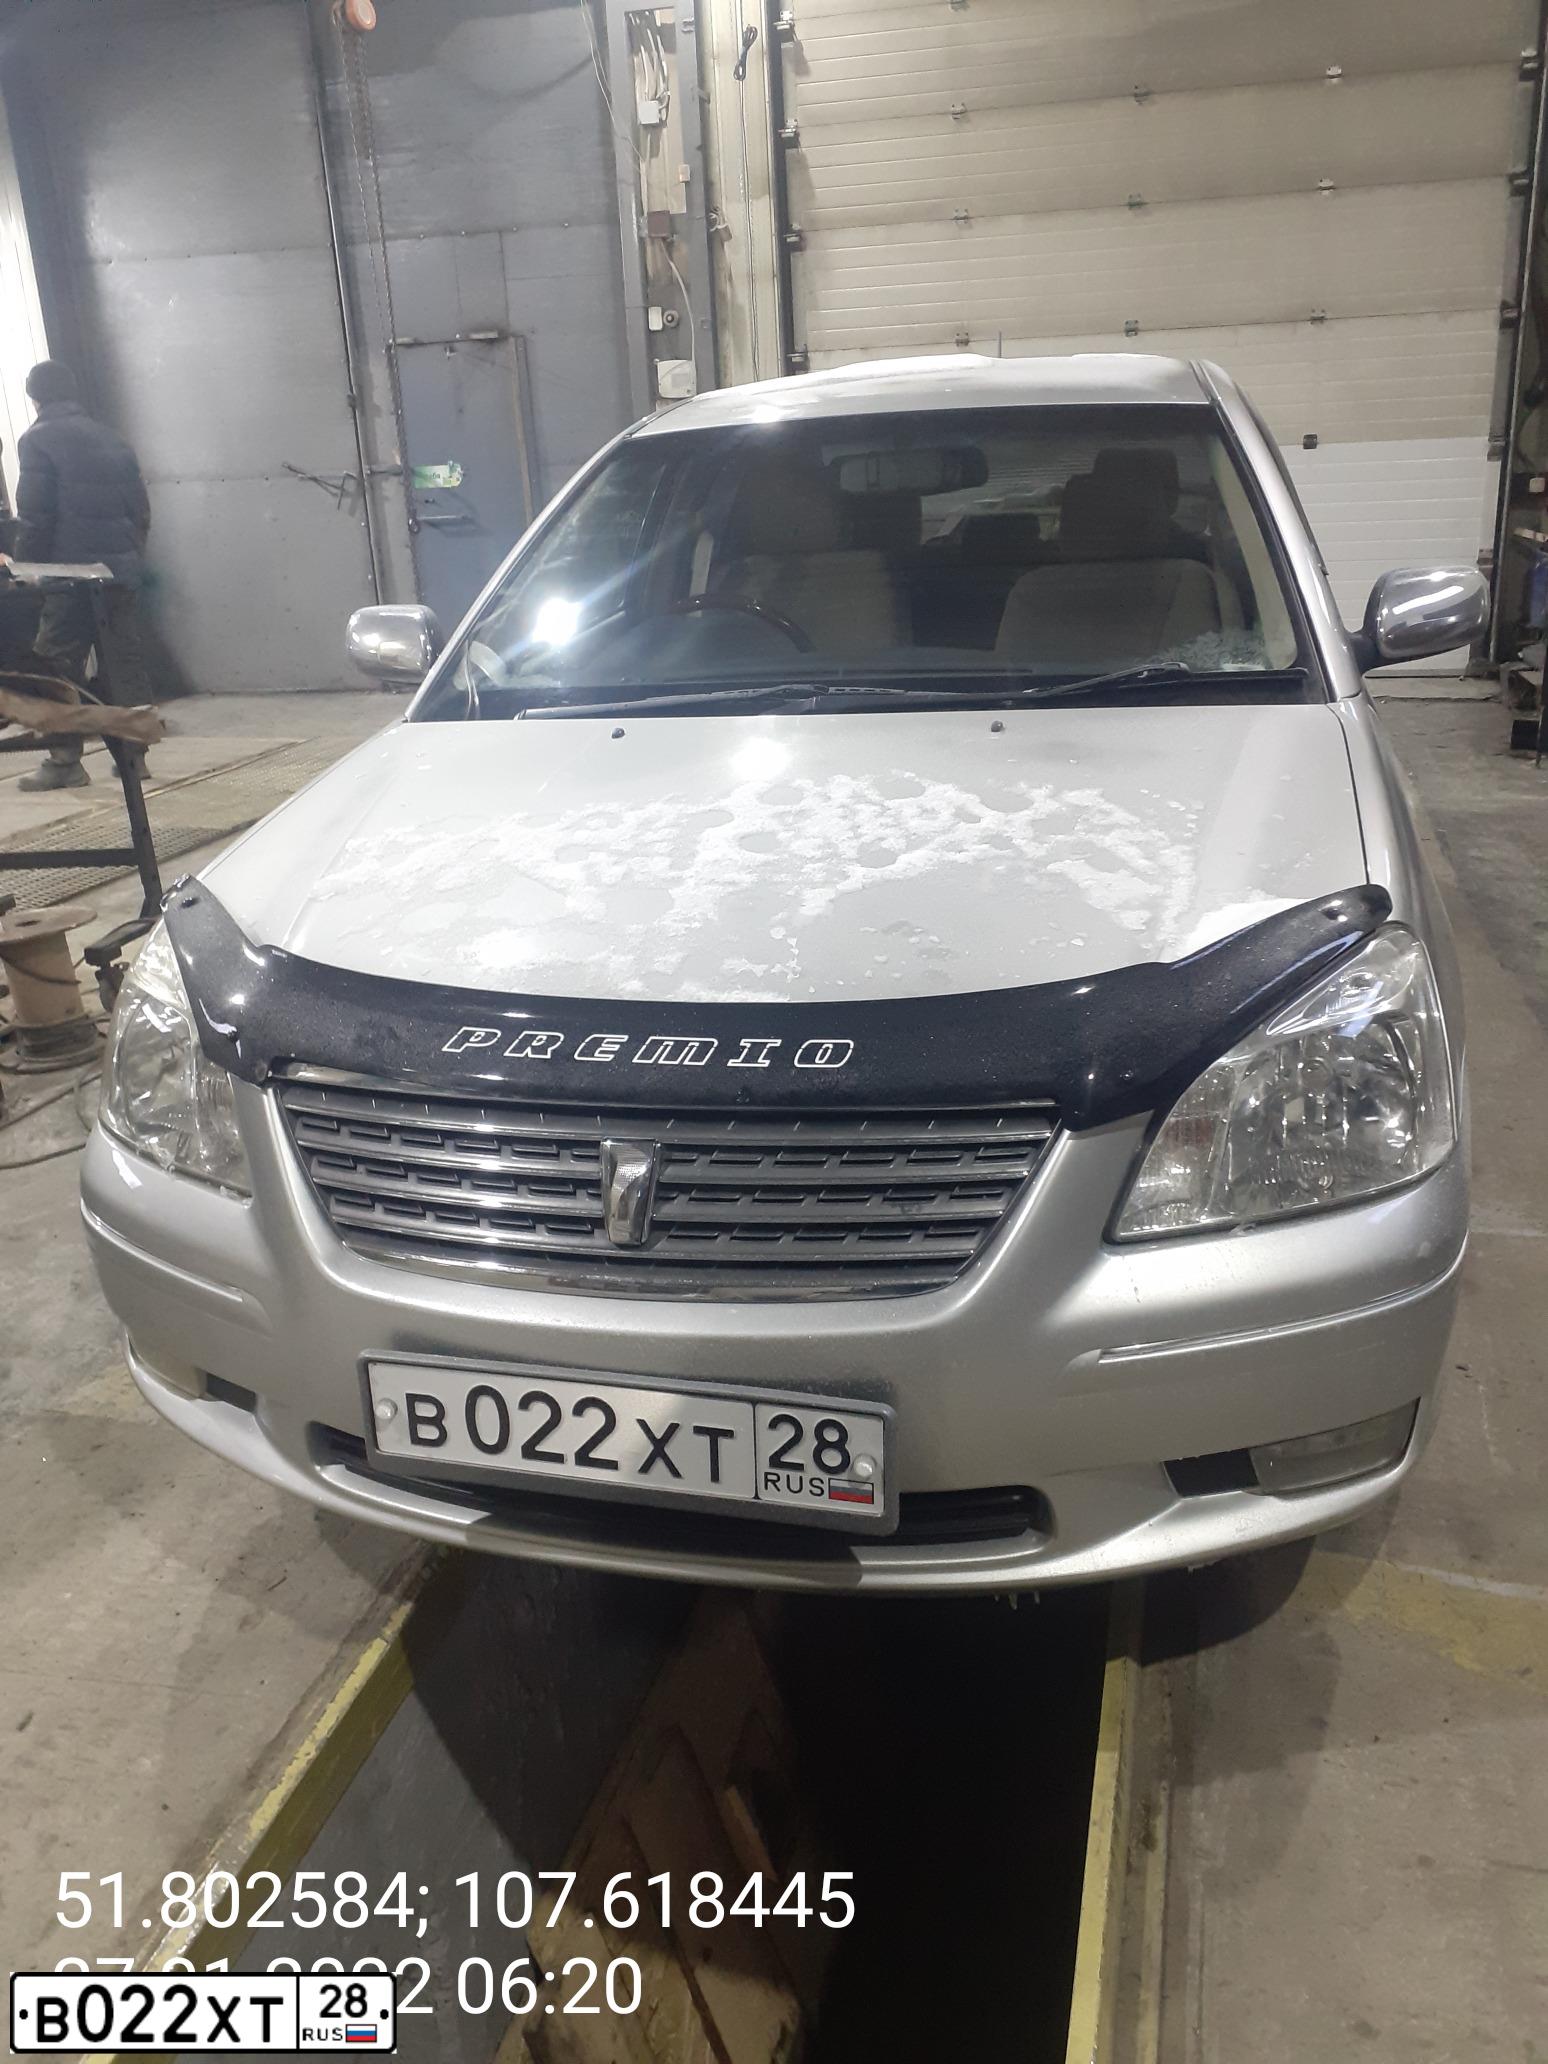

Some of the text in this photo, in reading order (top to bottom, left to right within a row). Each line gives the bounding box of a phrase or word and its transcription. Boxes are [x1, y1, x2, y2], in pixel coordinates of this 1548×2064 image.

[441, 1026, 855, 1069] PREMIO
[767, 1413, 852, 1476] 28
[763, 1471, 828, 1499] RUS
